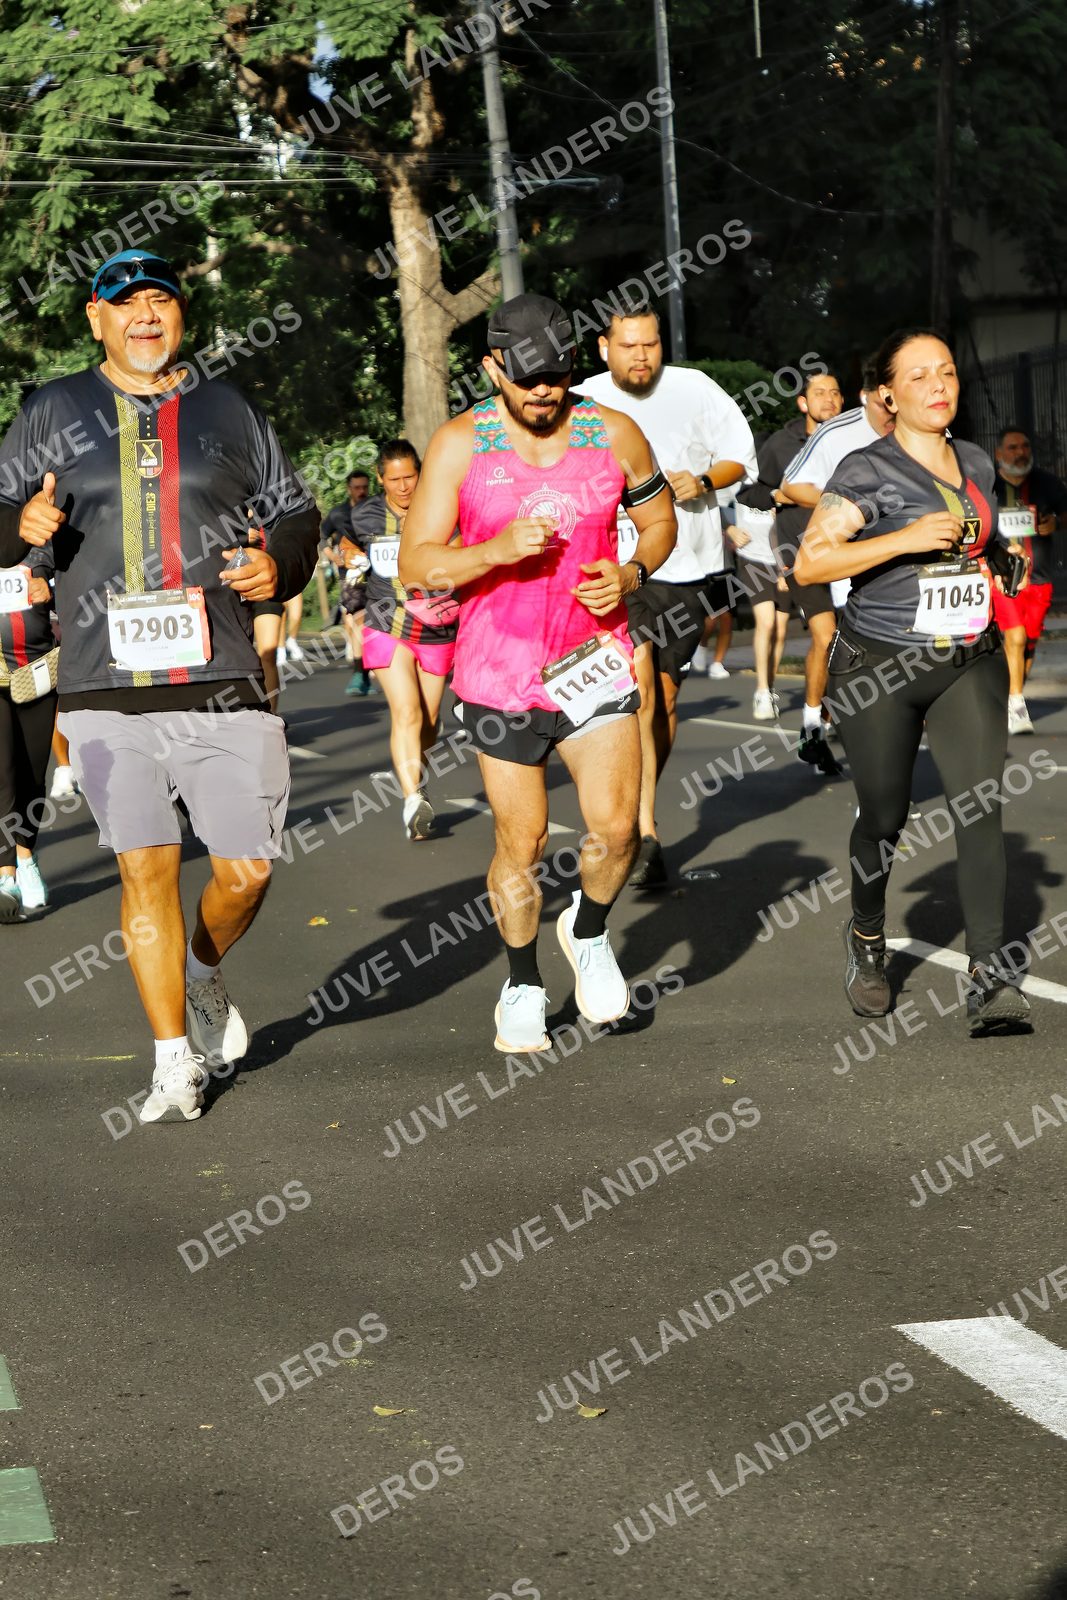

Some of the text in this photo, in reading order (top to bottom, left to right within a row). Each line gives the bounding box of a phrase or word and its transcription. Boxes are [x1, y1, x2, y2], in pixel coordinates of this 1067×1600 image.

[923, 583, 985, 610] 11045
[114, 613, 194, 644] 12903
[554, 654, 623, 702] 11416
